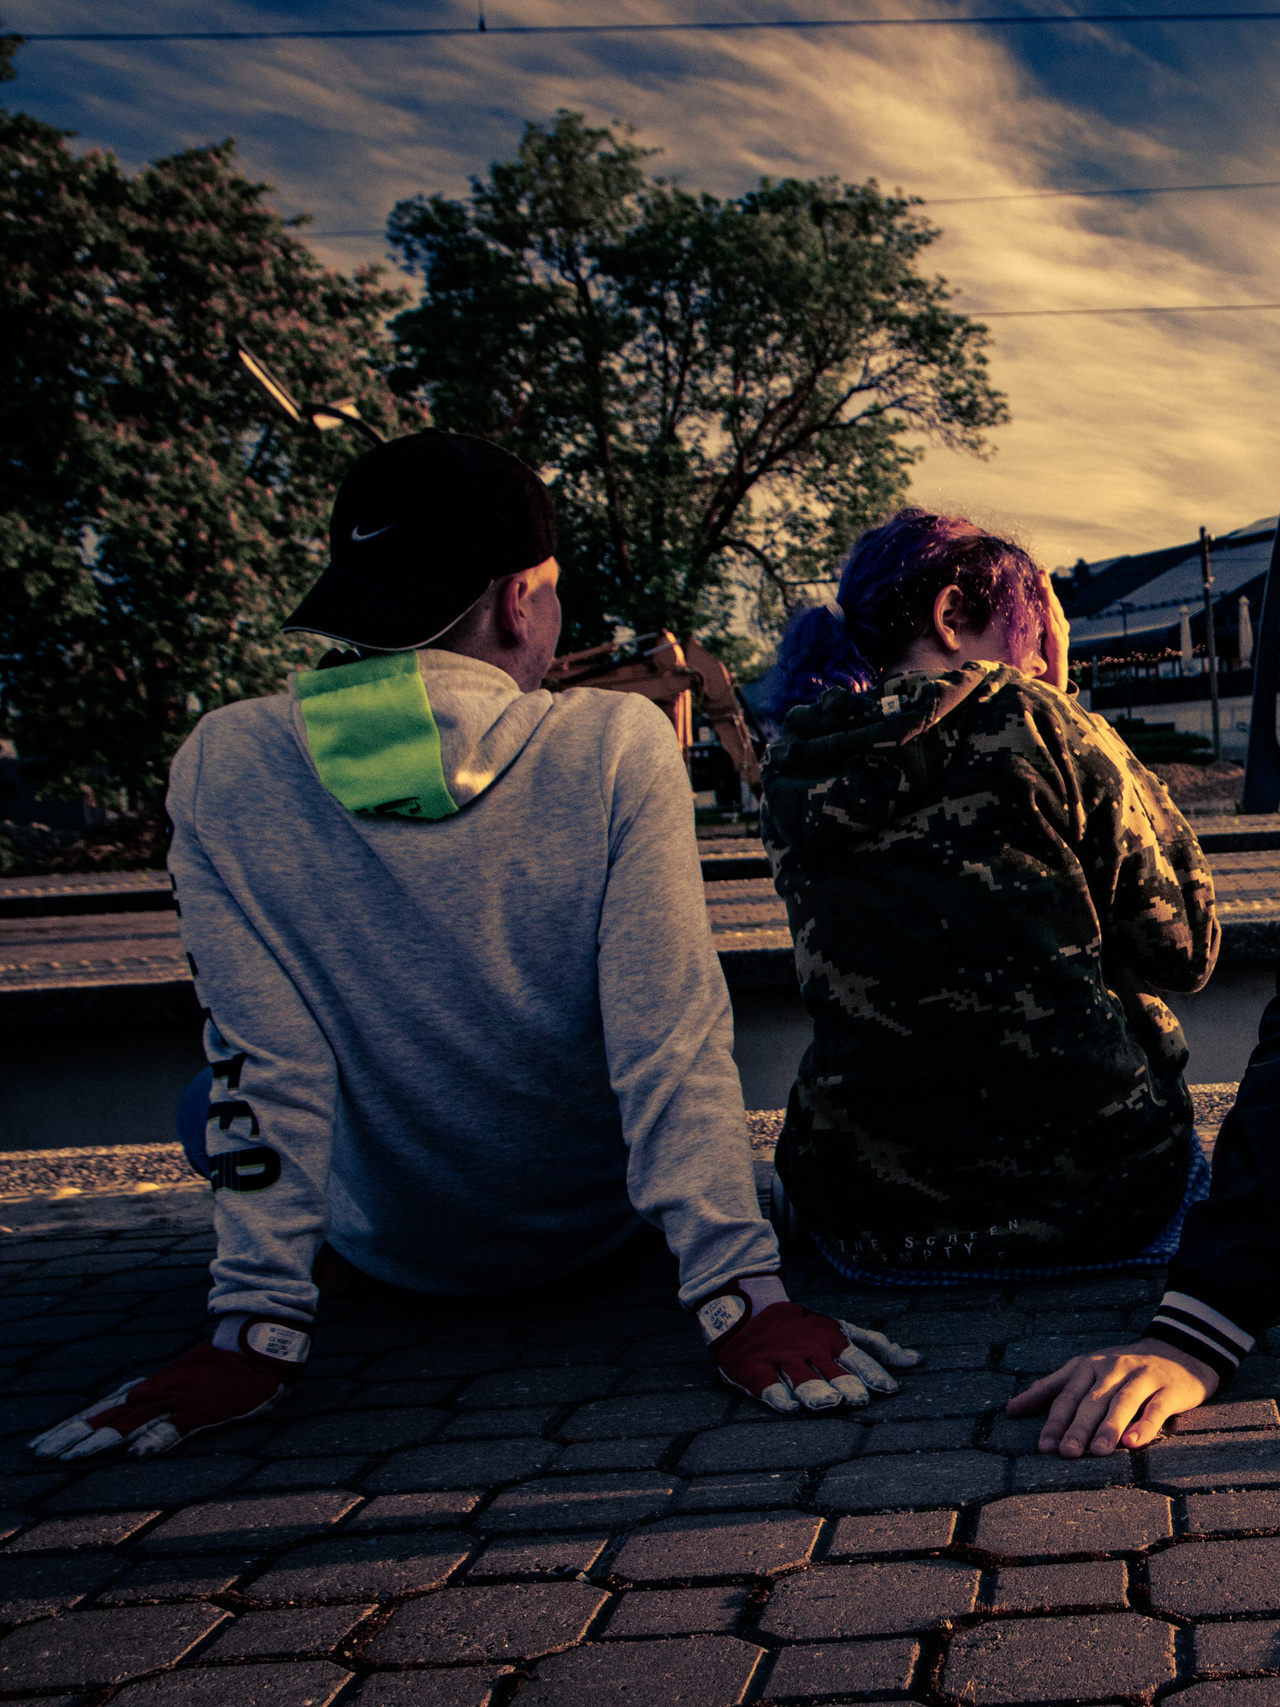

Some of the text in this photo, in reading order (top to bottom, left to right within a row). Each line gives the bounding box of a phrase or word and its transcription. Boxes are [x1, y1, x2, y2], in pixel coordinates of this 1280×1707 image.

[839, 1218, 1019, 1252] THE SCREEN
[881, 1242, 974, 1264] EMPTY
